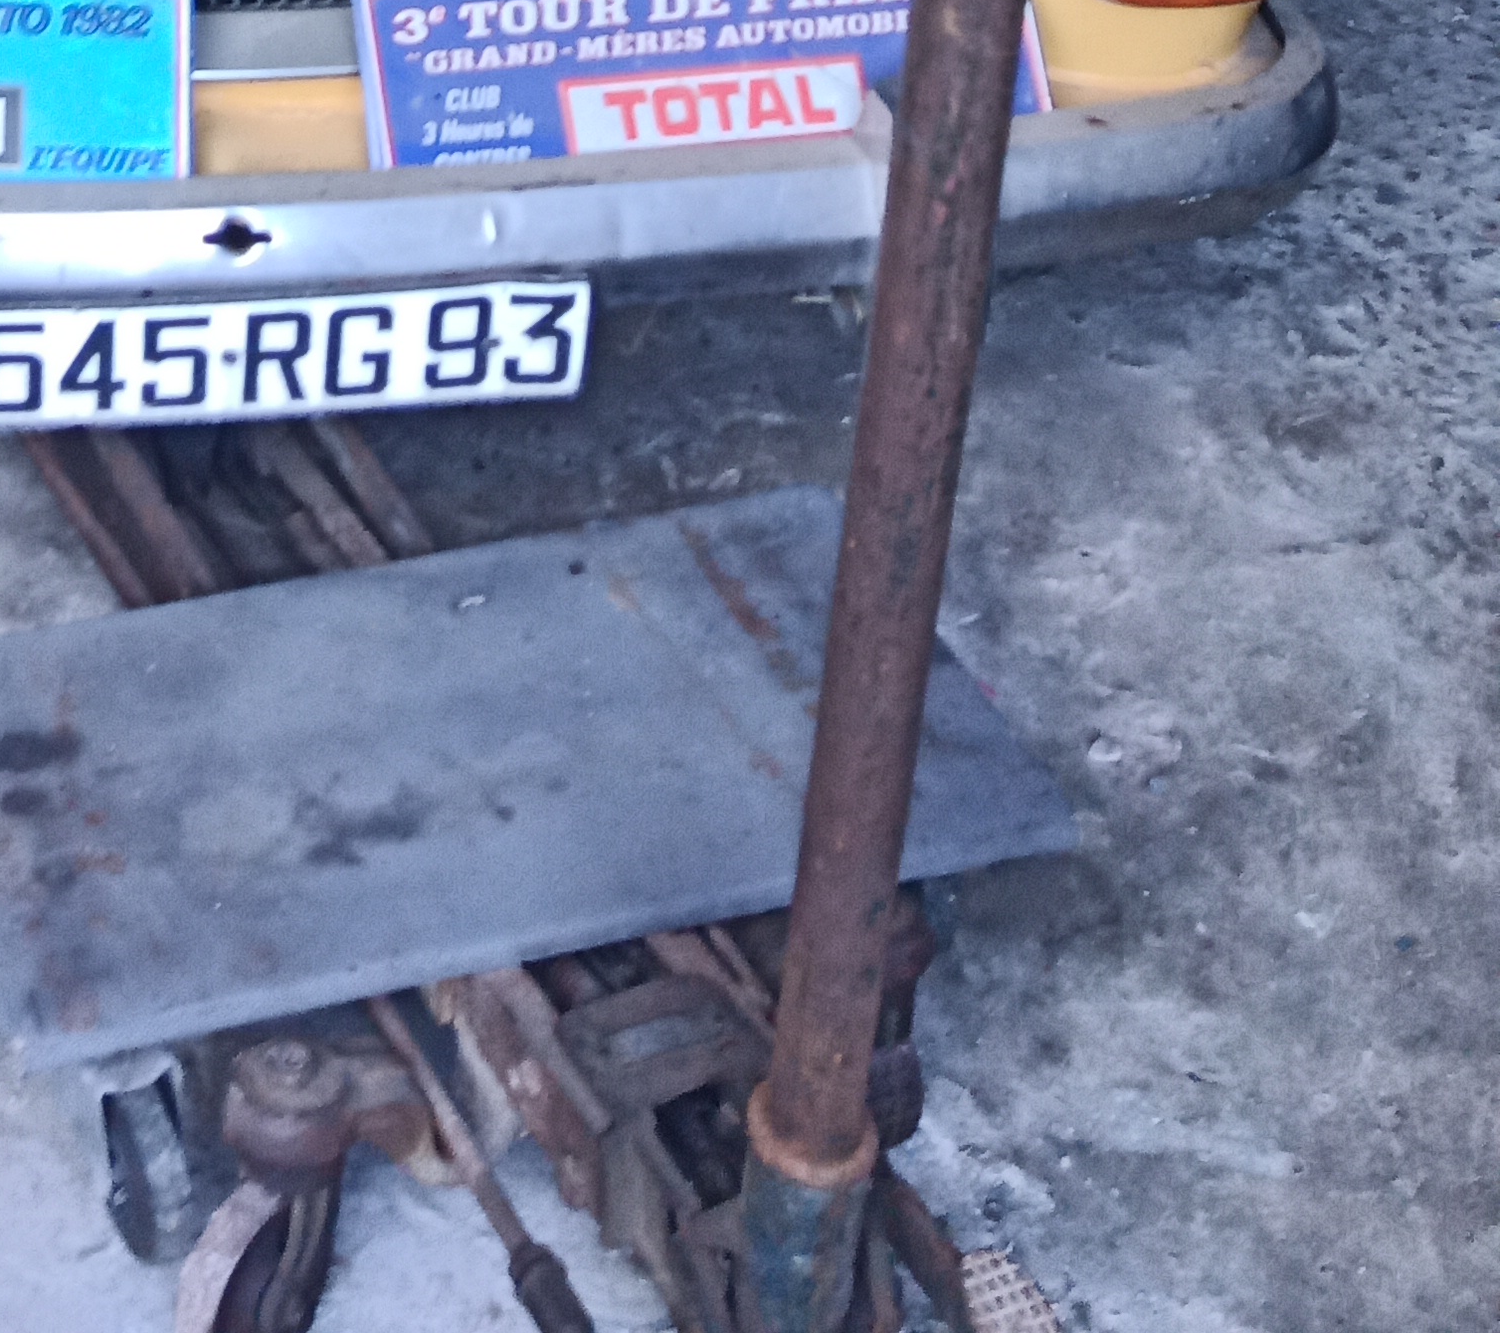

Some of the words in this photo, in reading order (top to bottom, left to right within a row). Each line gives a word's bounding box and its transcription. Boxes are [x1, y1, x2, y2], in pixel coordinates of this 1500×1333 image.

[59, 1, 154, 37] 1982
[443, 84, 502, 113] CLUB
[603, 74, 836, 141] TOTAL
[243, 304, 394, 404] RG
[424, 292, 577, 390] 93
